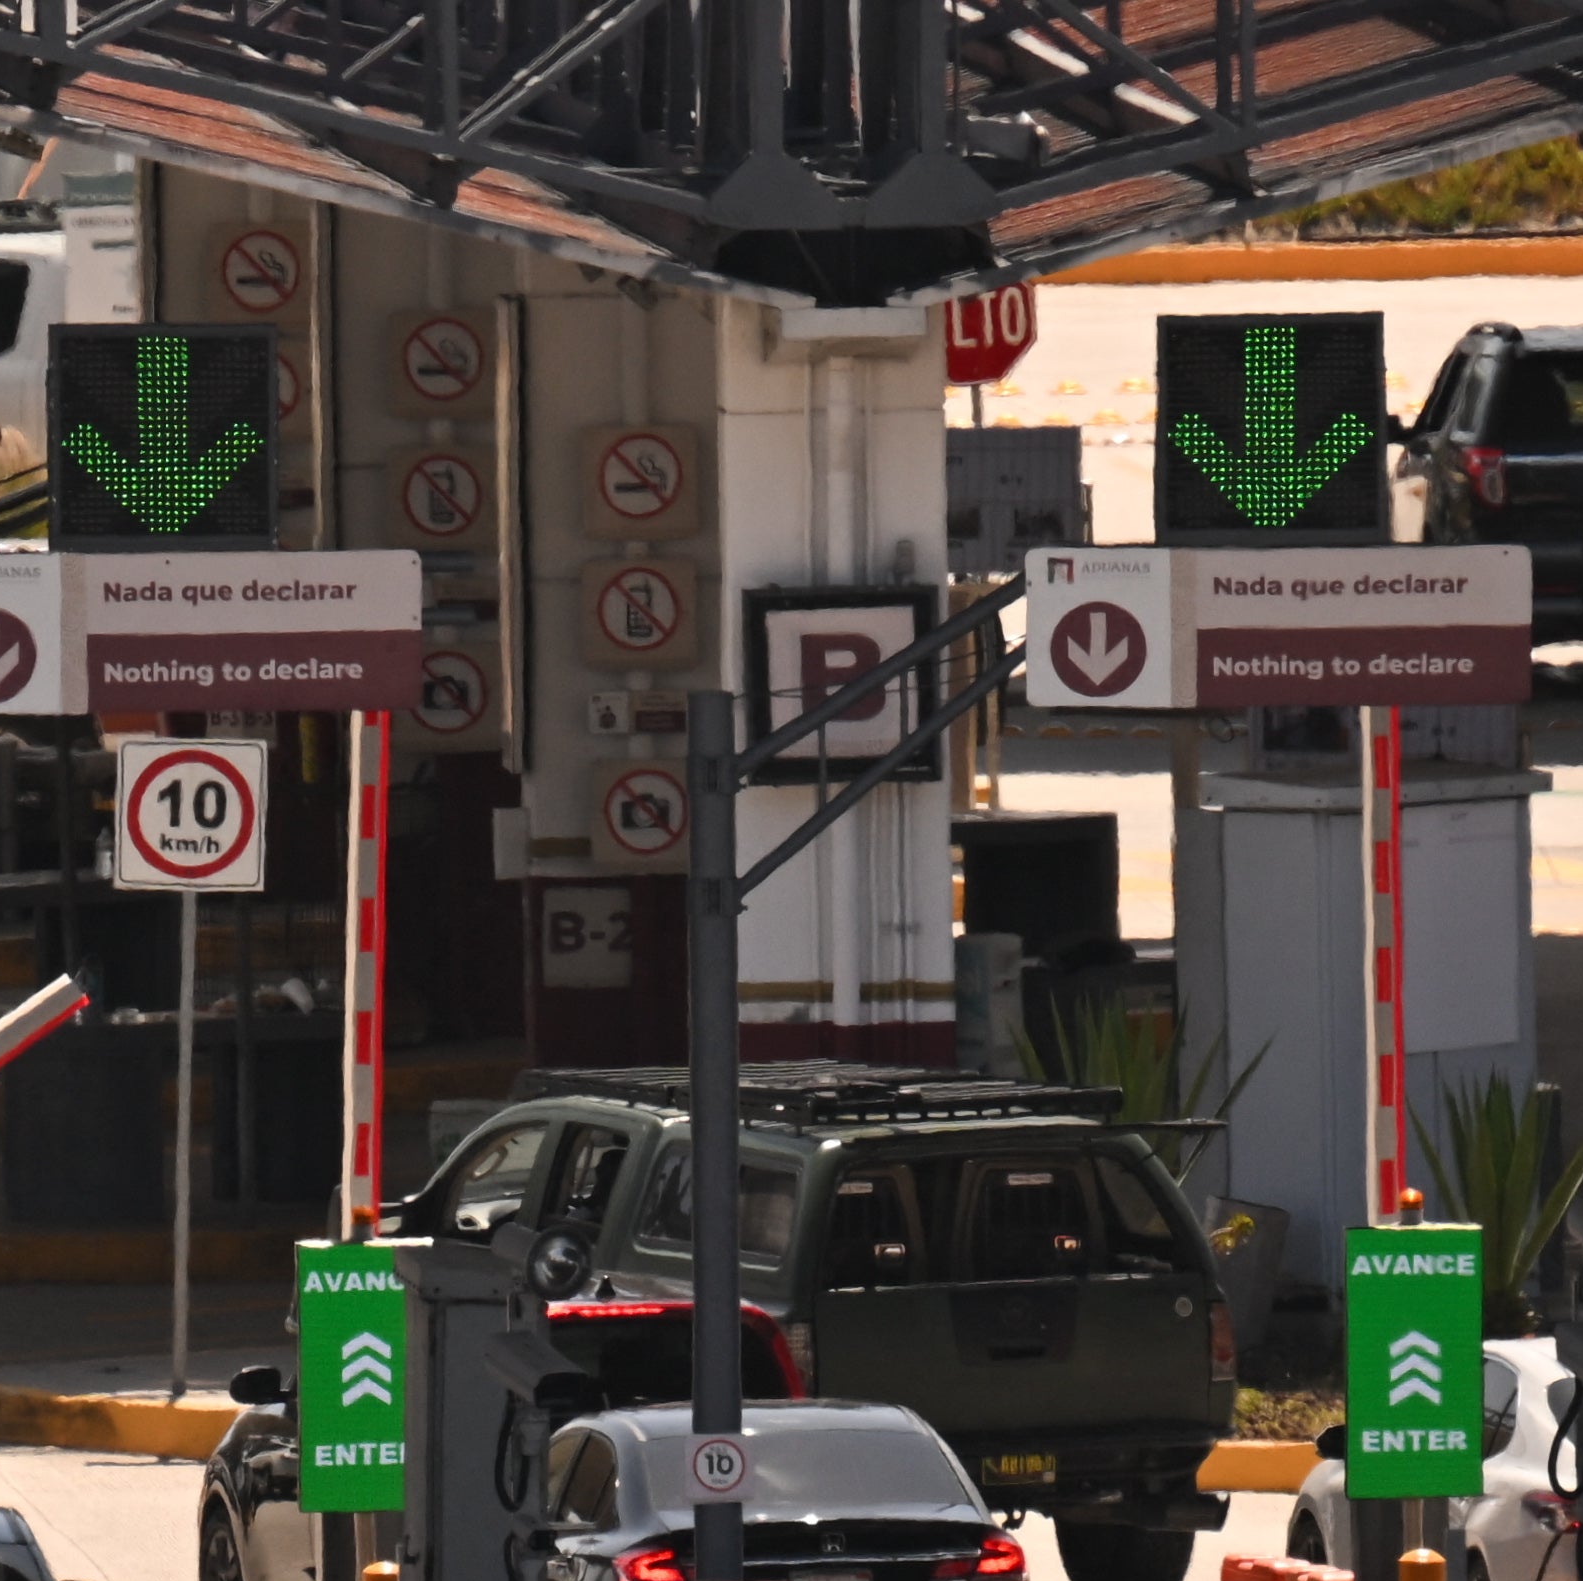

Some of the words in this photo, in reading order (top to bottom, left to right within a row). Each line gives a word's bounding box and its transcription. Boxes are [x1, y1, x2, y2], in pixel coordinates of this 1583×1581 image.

[952, 285, 1027, 348] LTO
[103, 582, 175, 605] Nada
[182, 585, 234, 609] que
[242, 580, 358, 603] declarar
[1213, 576, 1284, 598] Nada
[1290, 580, 1346, 602] que
[1354, 574, 1471, 597] declarar
[104, 660, 216, 689] Nothing
[222, 663, 253, 684] to
[259, 658, 364, 683] declare
[801, 633, 886, 721] B
[1213, 655, 1325, 682] Nothing
[1332, 657, 1362, 678] to
[1369, 654, 1476, 677] declare
[156, 778, 228, 829] 10
[159, 833, 221, 857] km/h
[549, 909, 637, 955] B-2
[1352, 1254, 1476, 1277] AVANCE
[304, 1271, 405, 1294] AVANC
[316, 1443, 405, 1469] ENTE
[1363, 1430, 1469, 1454] ENTER
[704, 1452, 735, 1476] 10
